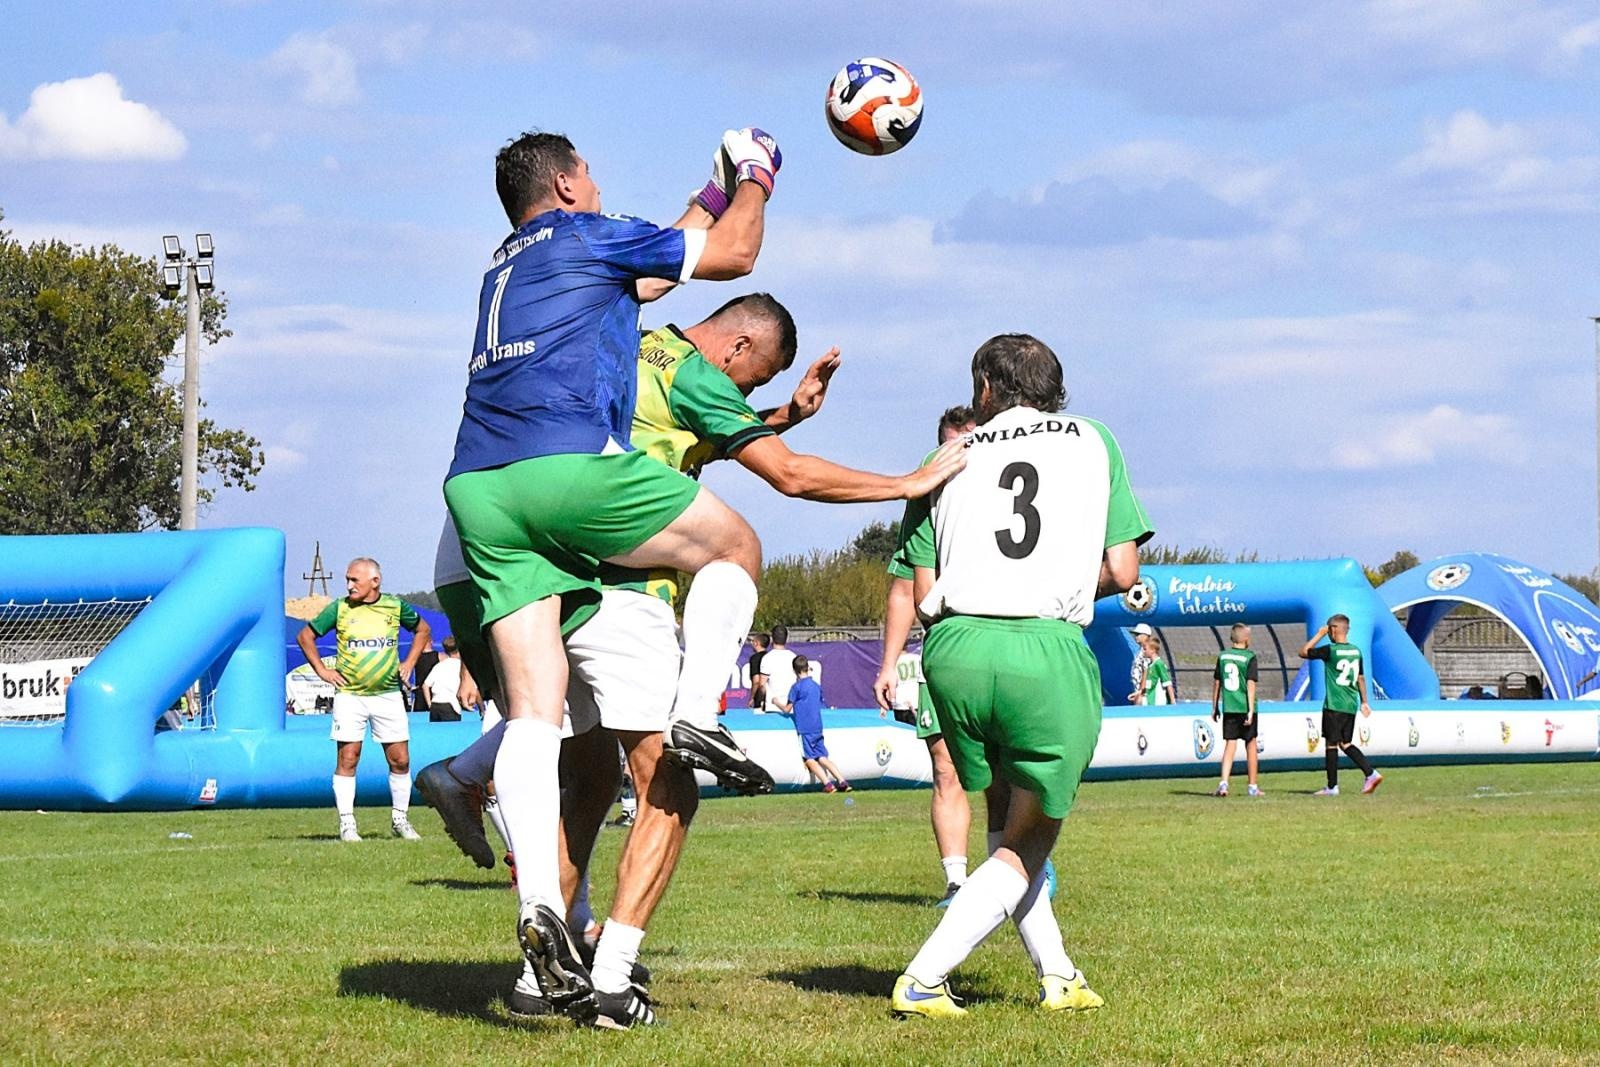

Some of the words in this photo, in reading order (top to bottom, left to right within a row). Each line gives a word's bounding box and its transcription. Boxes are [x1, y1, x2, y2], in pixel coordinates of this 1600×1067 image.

[487, 264, 514, 351] 1
[492, 340, 536, 362] Trans
[994, 461, 1042, 560] 3
[1169, 575, 1236, 600] Kopalnia
[1177, 595, 1248, 615] talentów
[347, 637, 395, 649] moya
[2, 669, 60, 699] bruk
[1223, 662, 1240, 692] 3
[1335, 658, 1360, 688] 21
